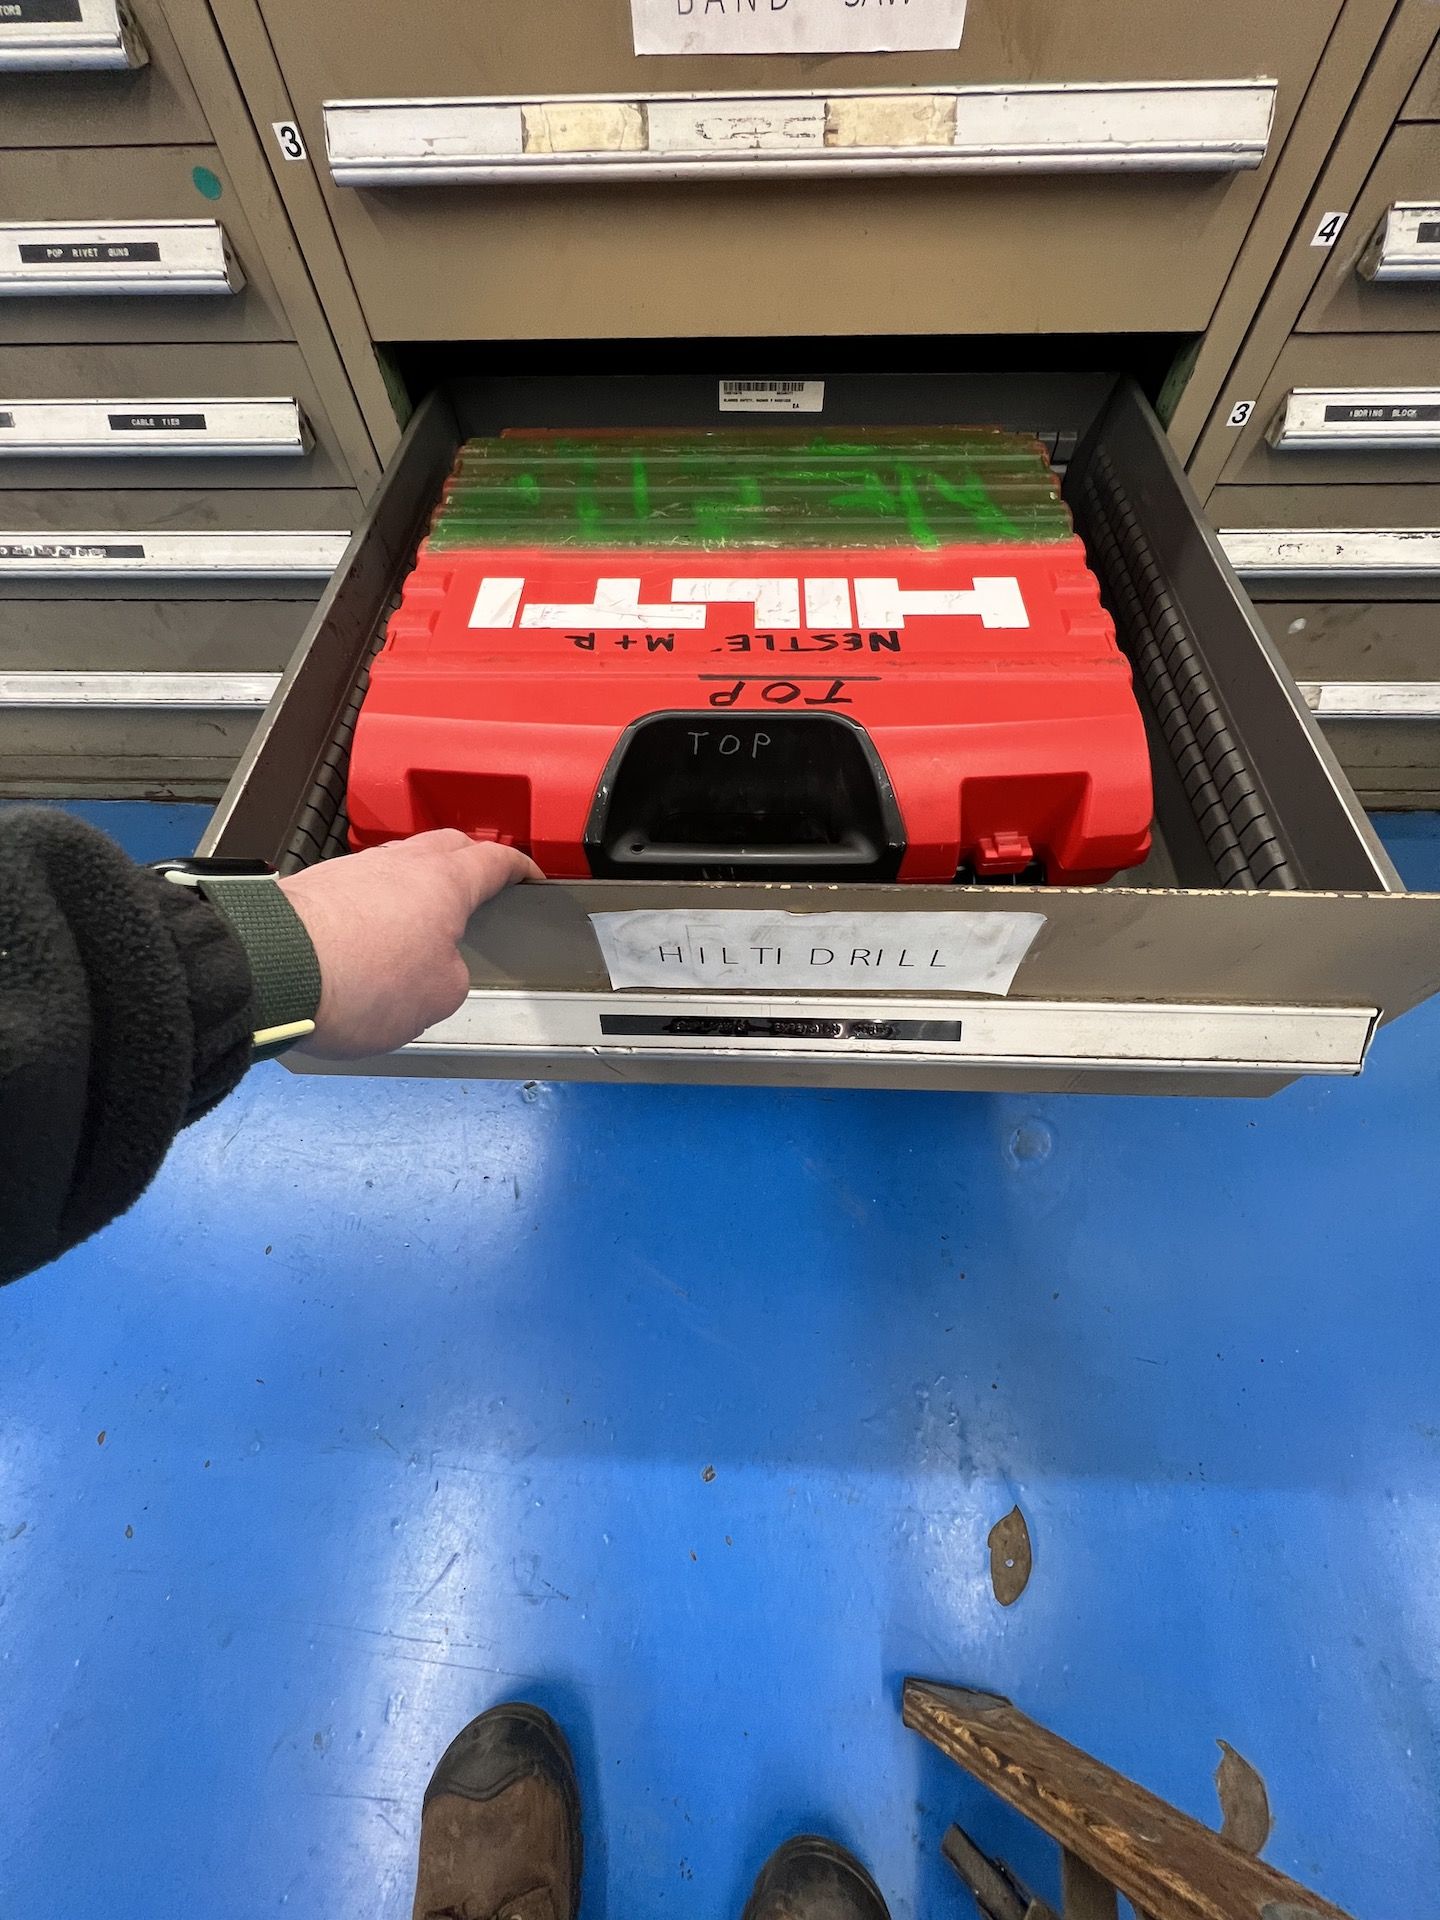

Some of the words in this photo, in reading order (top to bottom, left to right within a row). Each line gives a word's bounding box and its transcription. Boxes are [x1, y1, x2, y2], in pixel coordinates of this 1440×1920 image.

[280, 125, 302, 158] 3
[1318, 215, 1341, 243] 4
[46, 248, 64, 258] POP
[72, 247, 99, 258] RIVET
[131, 418, 155, 427] CABLE
[161, 417, 181, 427] TIES
[1231, 403, 1250, 424] 3
[467, 576, 1031, 629] HILTI
[708, 680, 853, 707] TOP
[687, 731, 772, 760] TOP
[658, 946, 782, 965] HILTI
[809, 947, 948, 968] DRILL
